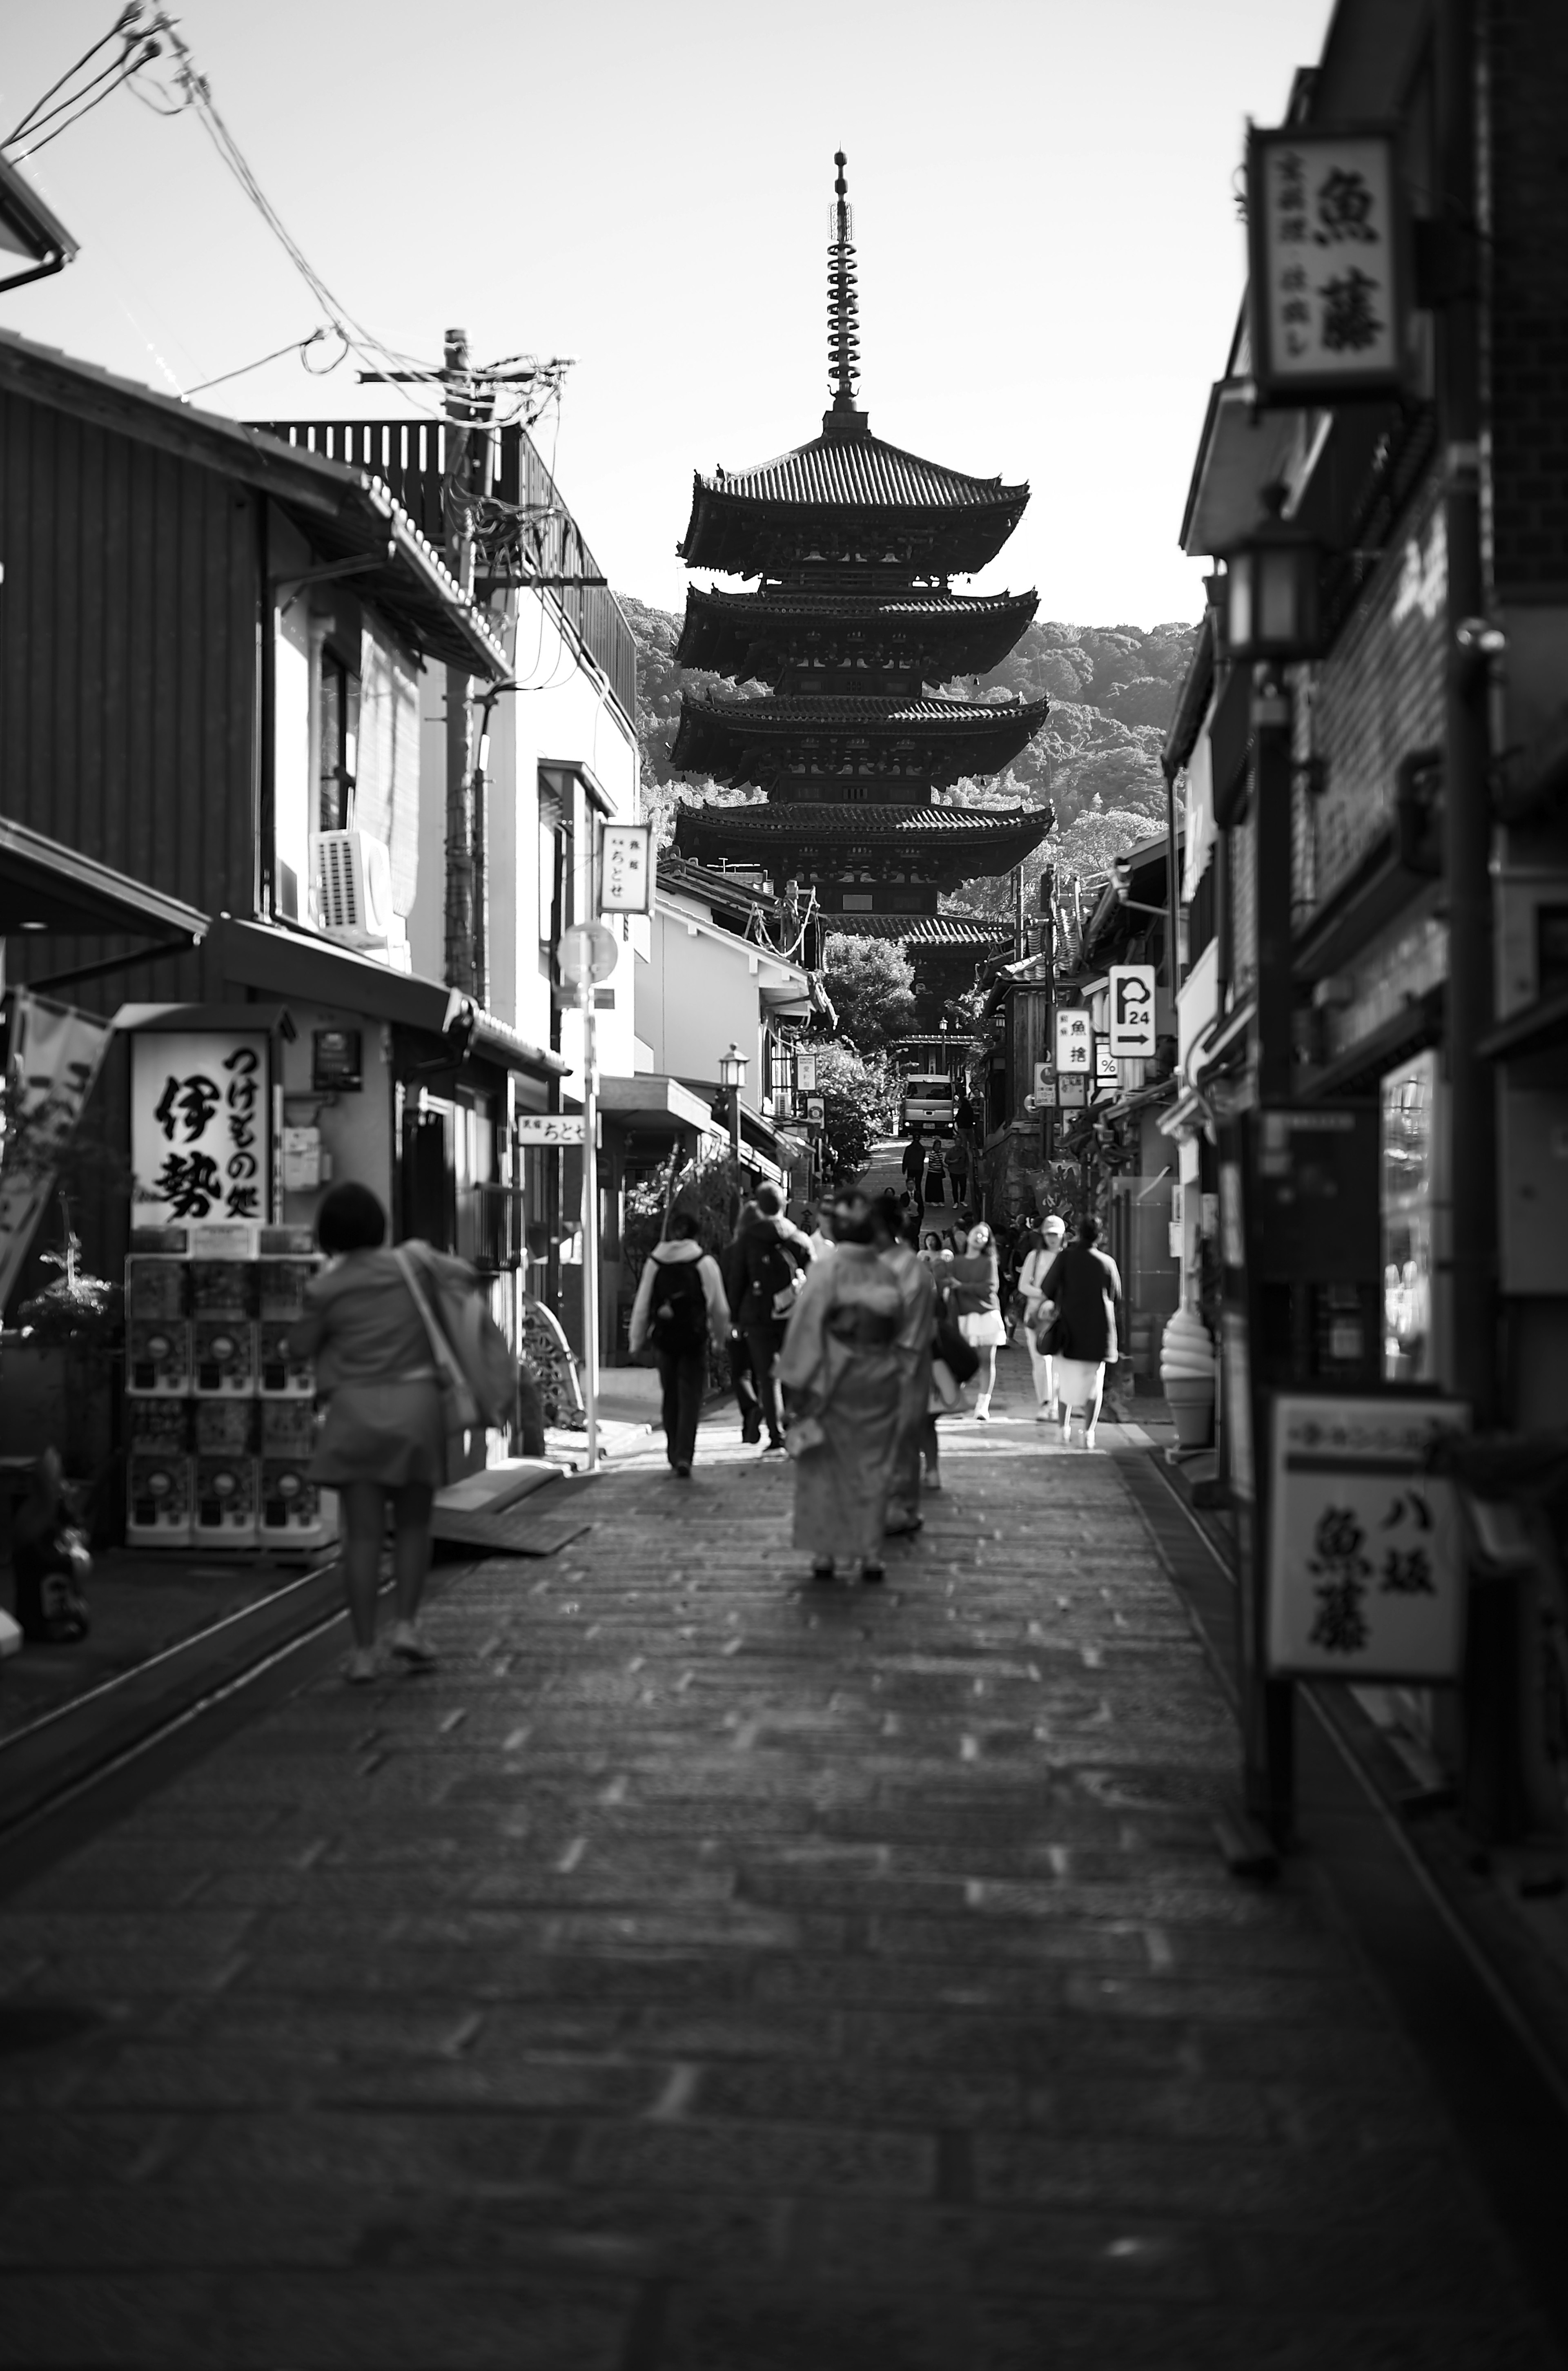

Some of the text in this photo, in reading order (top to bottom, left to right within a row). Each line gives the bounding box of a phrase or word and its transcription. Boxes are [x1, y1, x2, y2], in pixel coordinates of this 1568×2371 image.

[612, 850, 624, 897] ちとせ
[1129, 1011, 1149, 1024] 24
[153, 1074, 222, 1223] 伊勢
[223, 1046, 261, 1219] つけもの処
